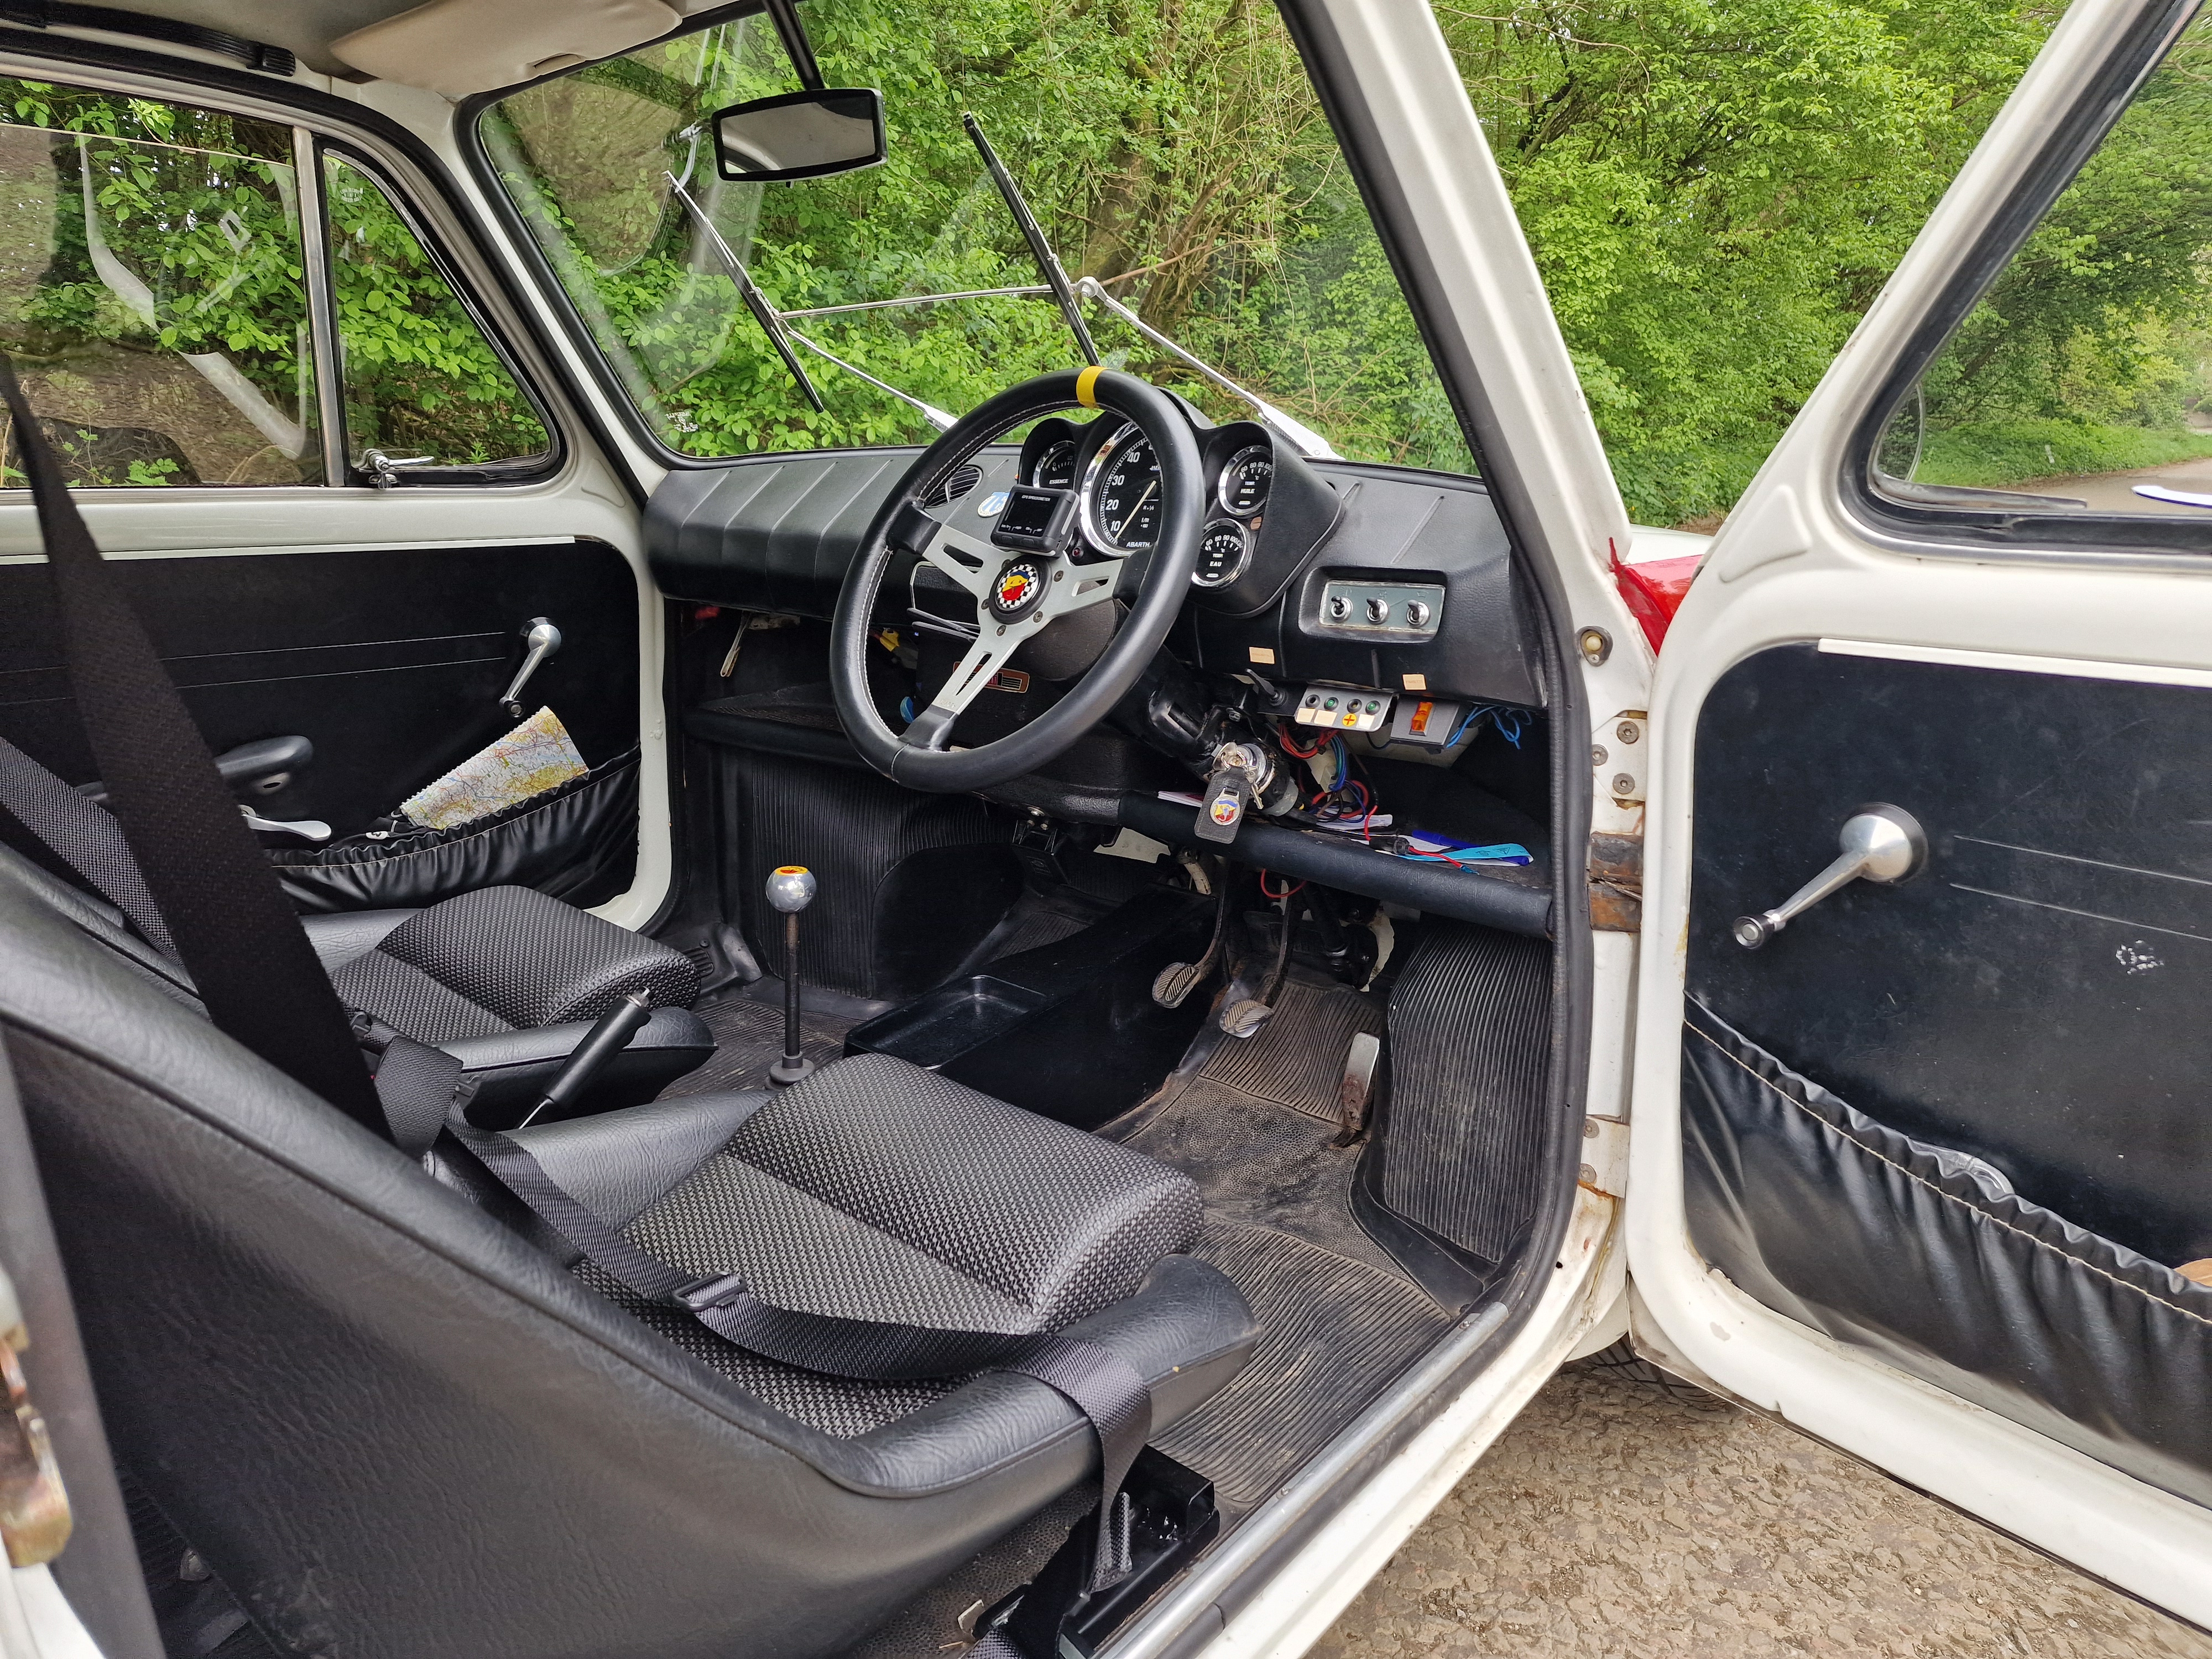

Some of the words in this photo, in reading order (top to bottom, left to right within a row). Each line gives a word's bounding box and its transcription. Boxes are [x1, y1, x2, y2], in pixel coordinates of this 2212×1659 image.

[1126, 452, 1140, 463] 40
[1111, 474, 1125, 486] 30
[1105, 499, 1119, 510] 20
[1110, 520, 1121, 531] 10
